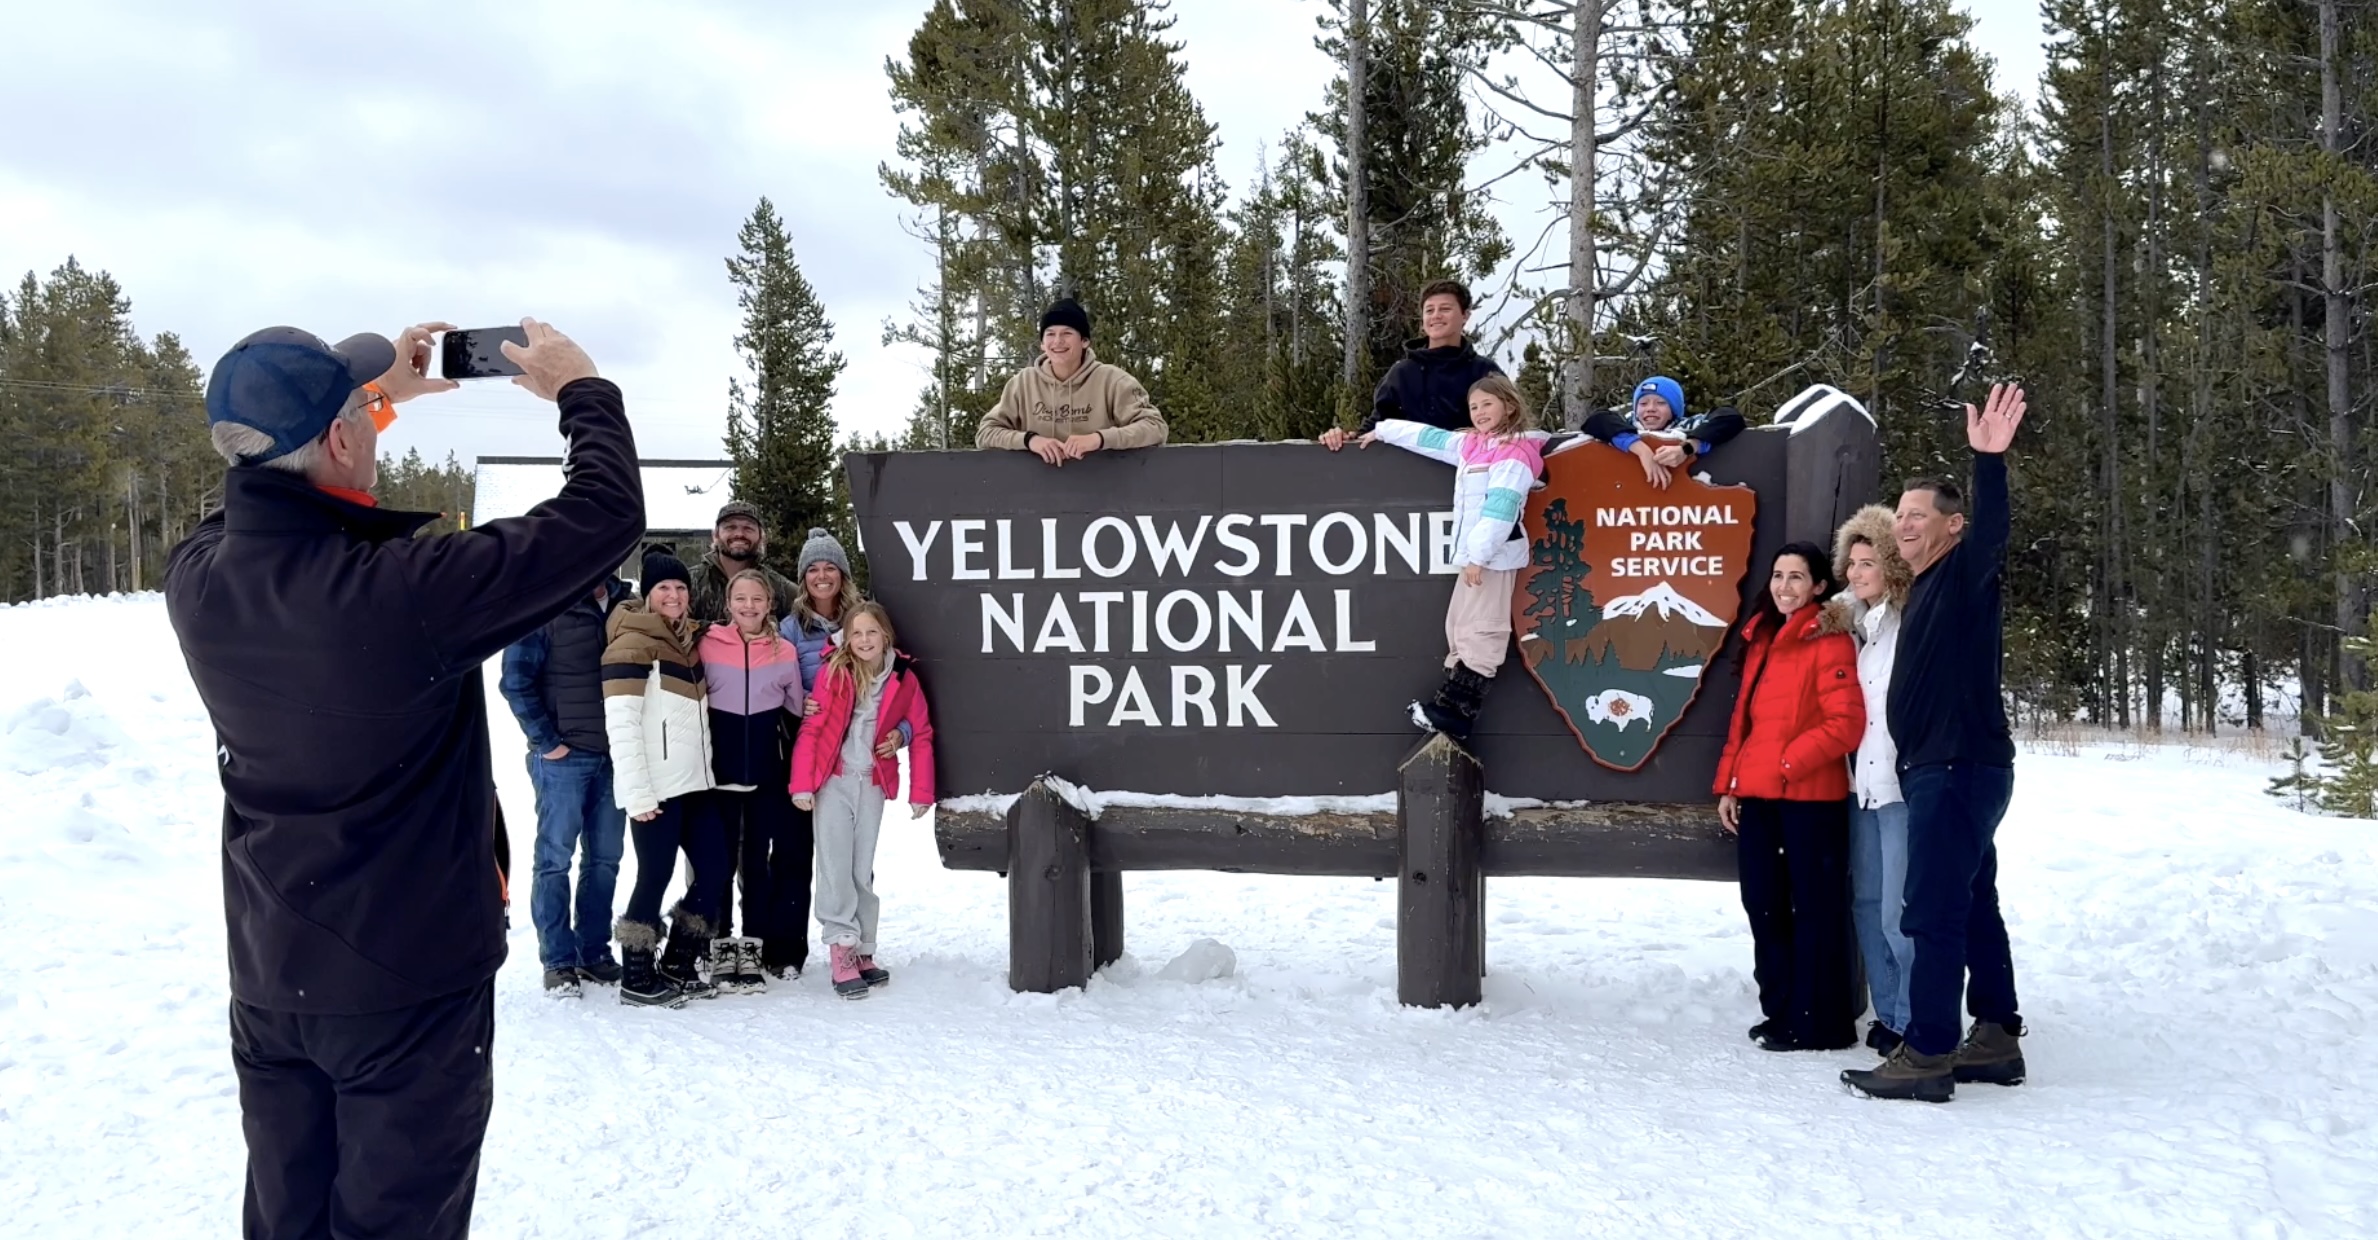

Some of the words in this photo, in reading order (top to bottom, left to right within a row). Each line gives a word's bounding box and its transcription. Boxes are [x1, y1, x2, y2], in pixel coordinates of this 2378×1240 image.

[1596, 505, 1739, 527] NATIONAL
[893, 511, 1461, 581] YELLOWSTONE
[1630, 531, 1703, 552] PARK
[1611, 556, 1723, 577] SERVICE
[981, 589, 1376, 653] NATIONAL
[1069, 664, 1279, 727] PARK
